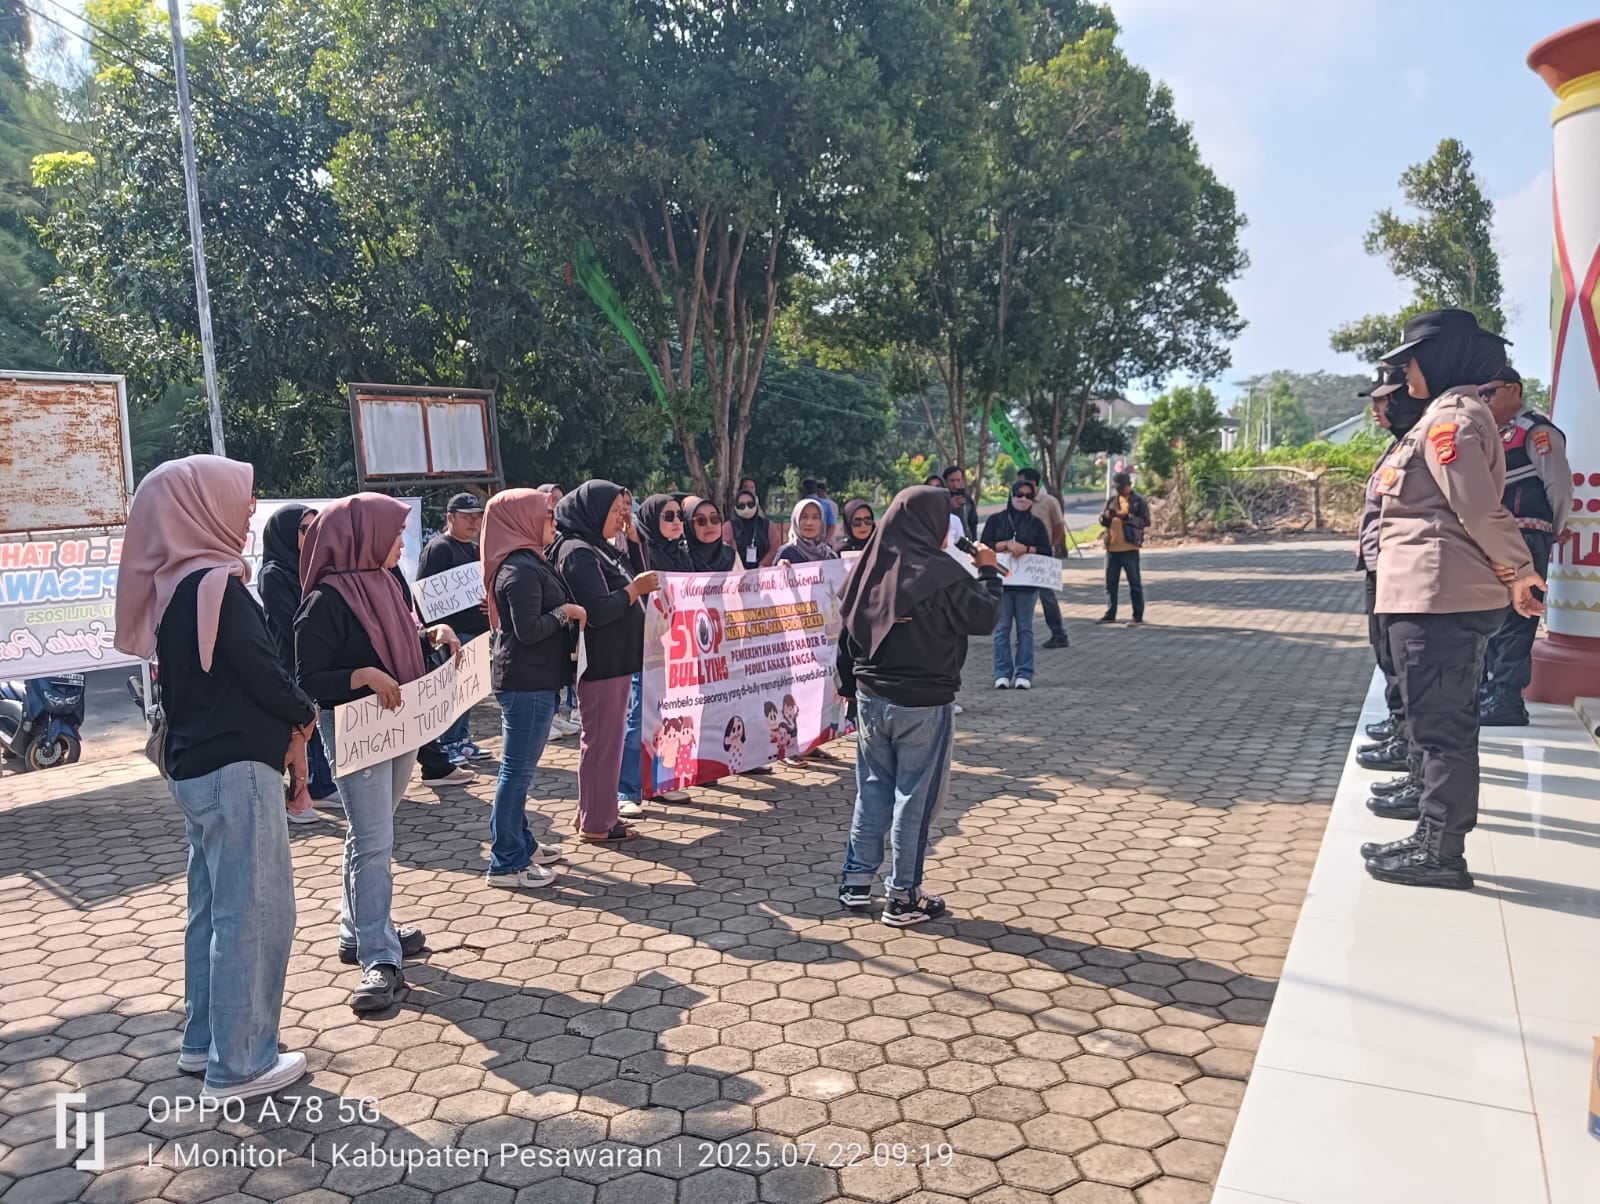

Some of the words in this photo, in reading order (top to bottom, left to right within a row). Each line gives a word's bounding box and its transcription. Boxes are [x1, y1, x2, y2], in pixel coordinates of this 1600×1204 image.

[418, 575, 449, 601] KEP
[450, 567, 482, 591] SEKO
[779, 568, 825, 591] Nasional
[426, 594, 460, 620] HARUS
[669, 608, 723, 660] STOP
[731, 642, 773, 661] PEMERINTAH
[772, 640, 795, 655] HARUS
[795, 637, 820, 650] HADIR
[668, 656, 729, 689] BULLYING
[744, 662, 766, 676] PEDULI
[767, 656, 786, 671] ANAK
[786, 651, 817, 668] BANGSA
[657, 695, 693, 711] Membela
[694, 692, 728, 706] seseorang
[727, 688, 742, 702] yang
[795, 668, 827, 685] kepedulian
[336, 722, 405, 768] JANGAN
[413, 700, 450, 737] TUTUP
[451, 673, 481, 713] MATA
[345, 695, 405, 733] DINS
